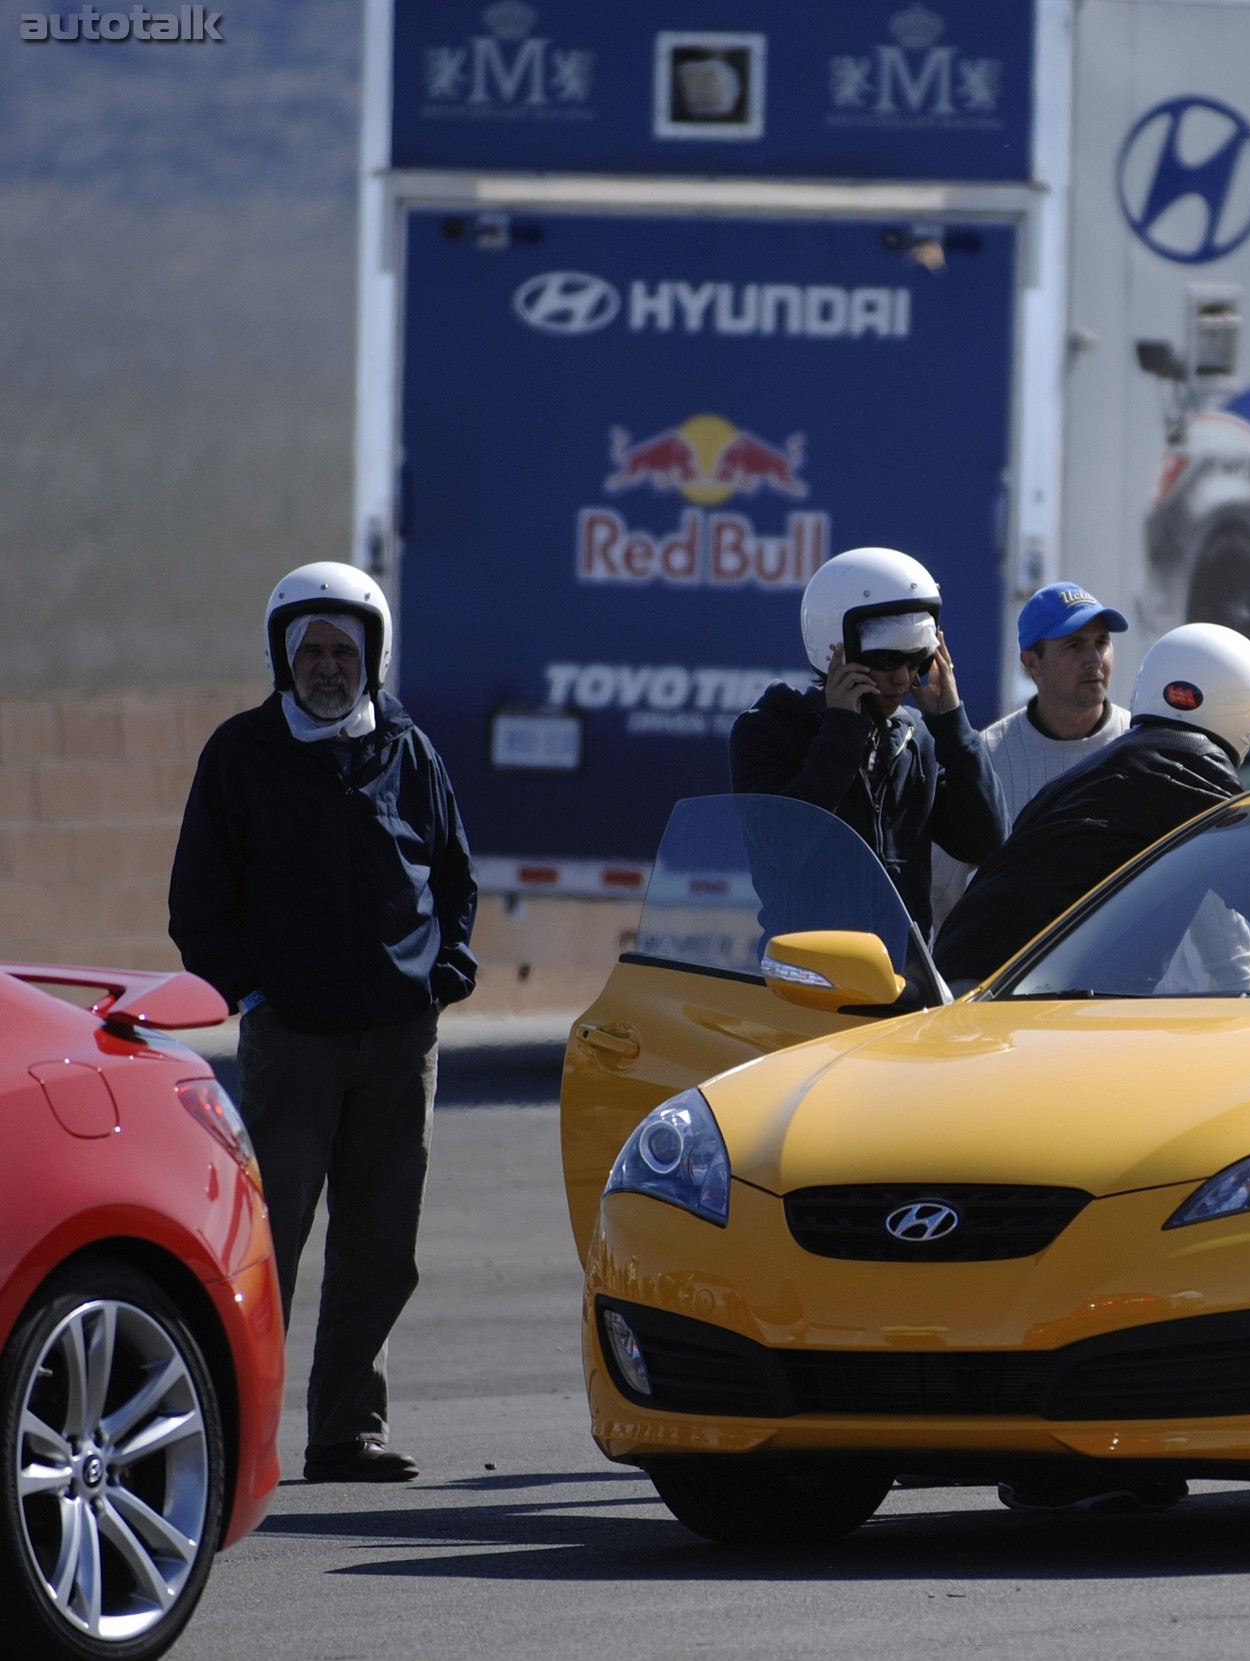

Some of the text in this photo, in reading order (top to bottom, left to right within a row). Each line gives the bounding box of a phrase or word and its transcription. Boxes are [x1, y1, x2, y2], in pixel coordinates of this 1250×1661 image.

[629, 282, 911, 337] HYUNDAI
[578, 510, 831, 585] Red Bull
[545, 664, 822, 710] TOYO TIR
